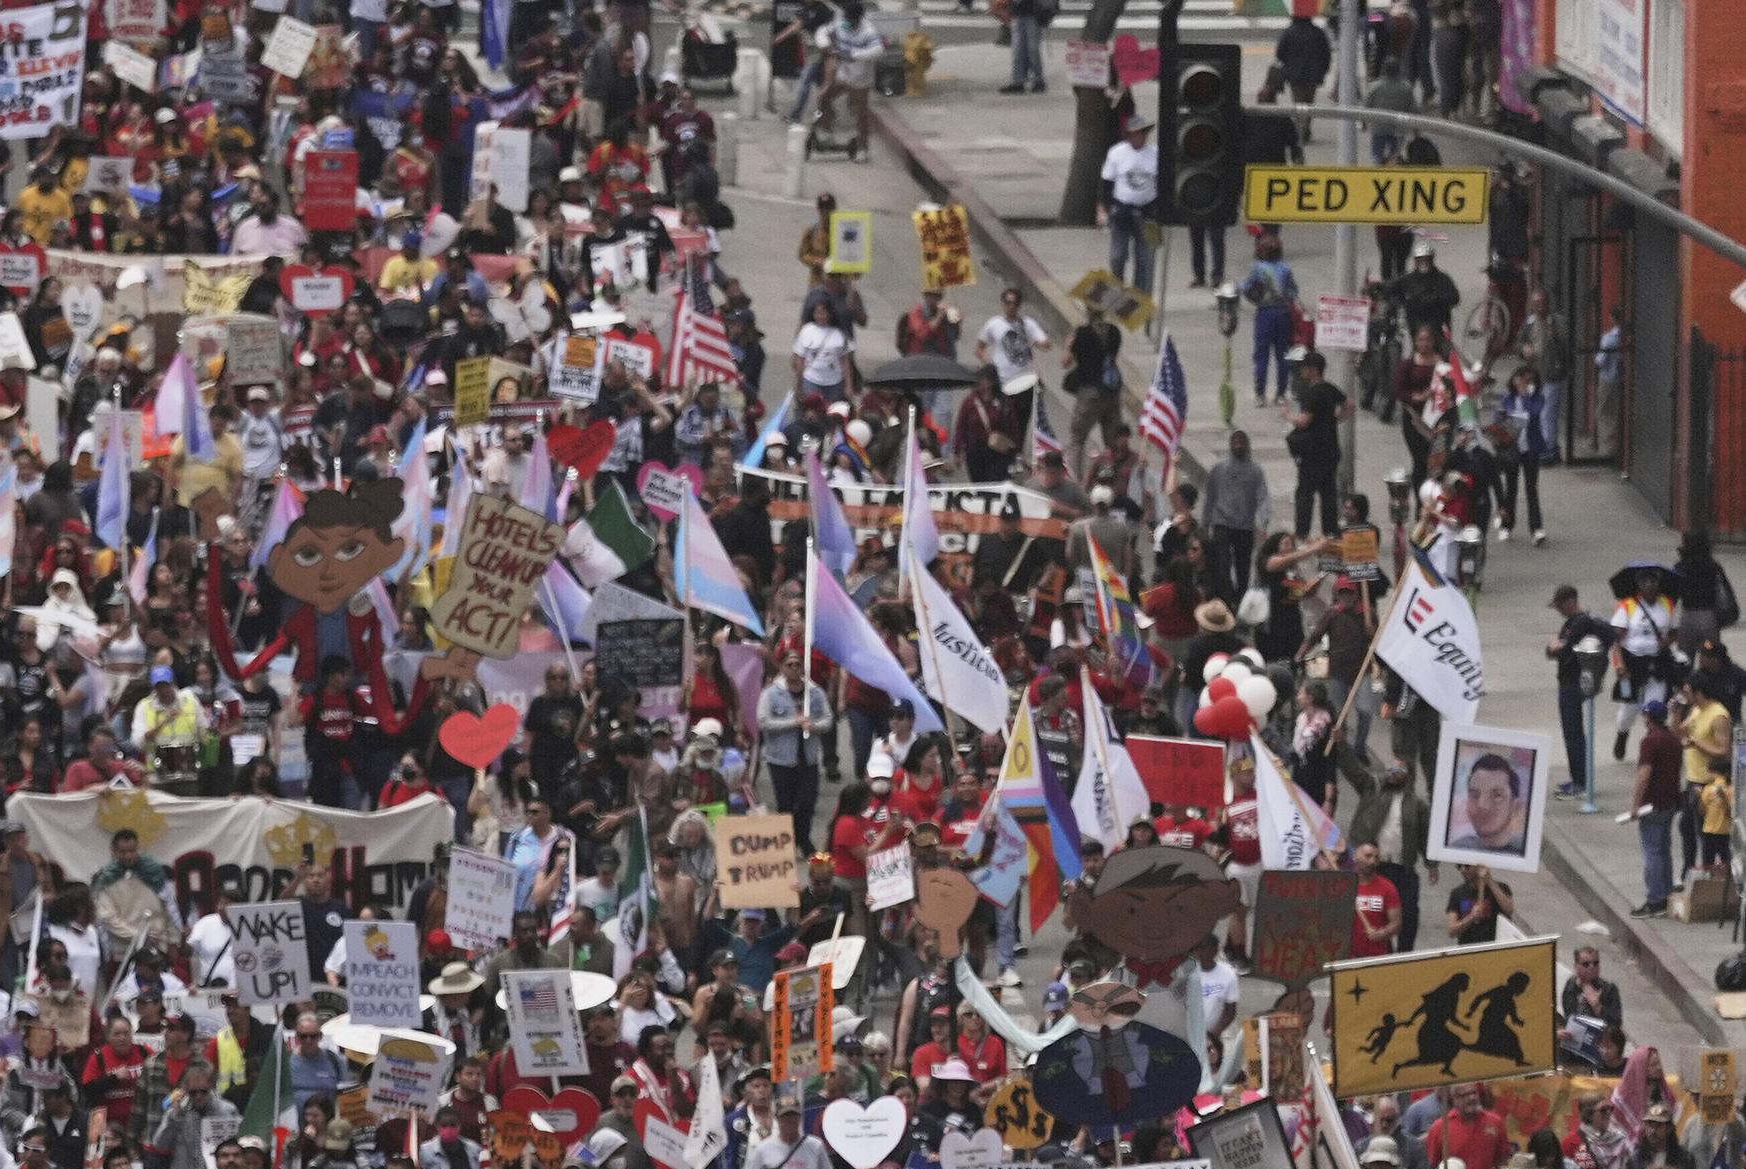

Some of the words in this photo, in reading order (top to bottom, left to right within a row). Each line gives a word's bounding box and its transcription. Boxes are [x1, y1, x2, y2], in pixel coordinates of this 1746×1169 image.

[1266, 179, 1348, 212] PED
[1370, 179, 1468, 215] XING
[471, 505, 556, 553] HOTELS
[443, 597, 517, 648] ACT!
[1420, 621, 1485, 699] Equity
[731, 832, 791, 857] DUMP
[728, 860, 795, 886] TRUMP
[227, 910, 306, 945] WAKE
[253, 973, 299, 1000] UP!
[350, 983, 416, 998] CONVICT
